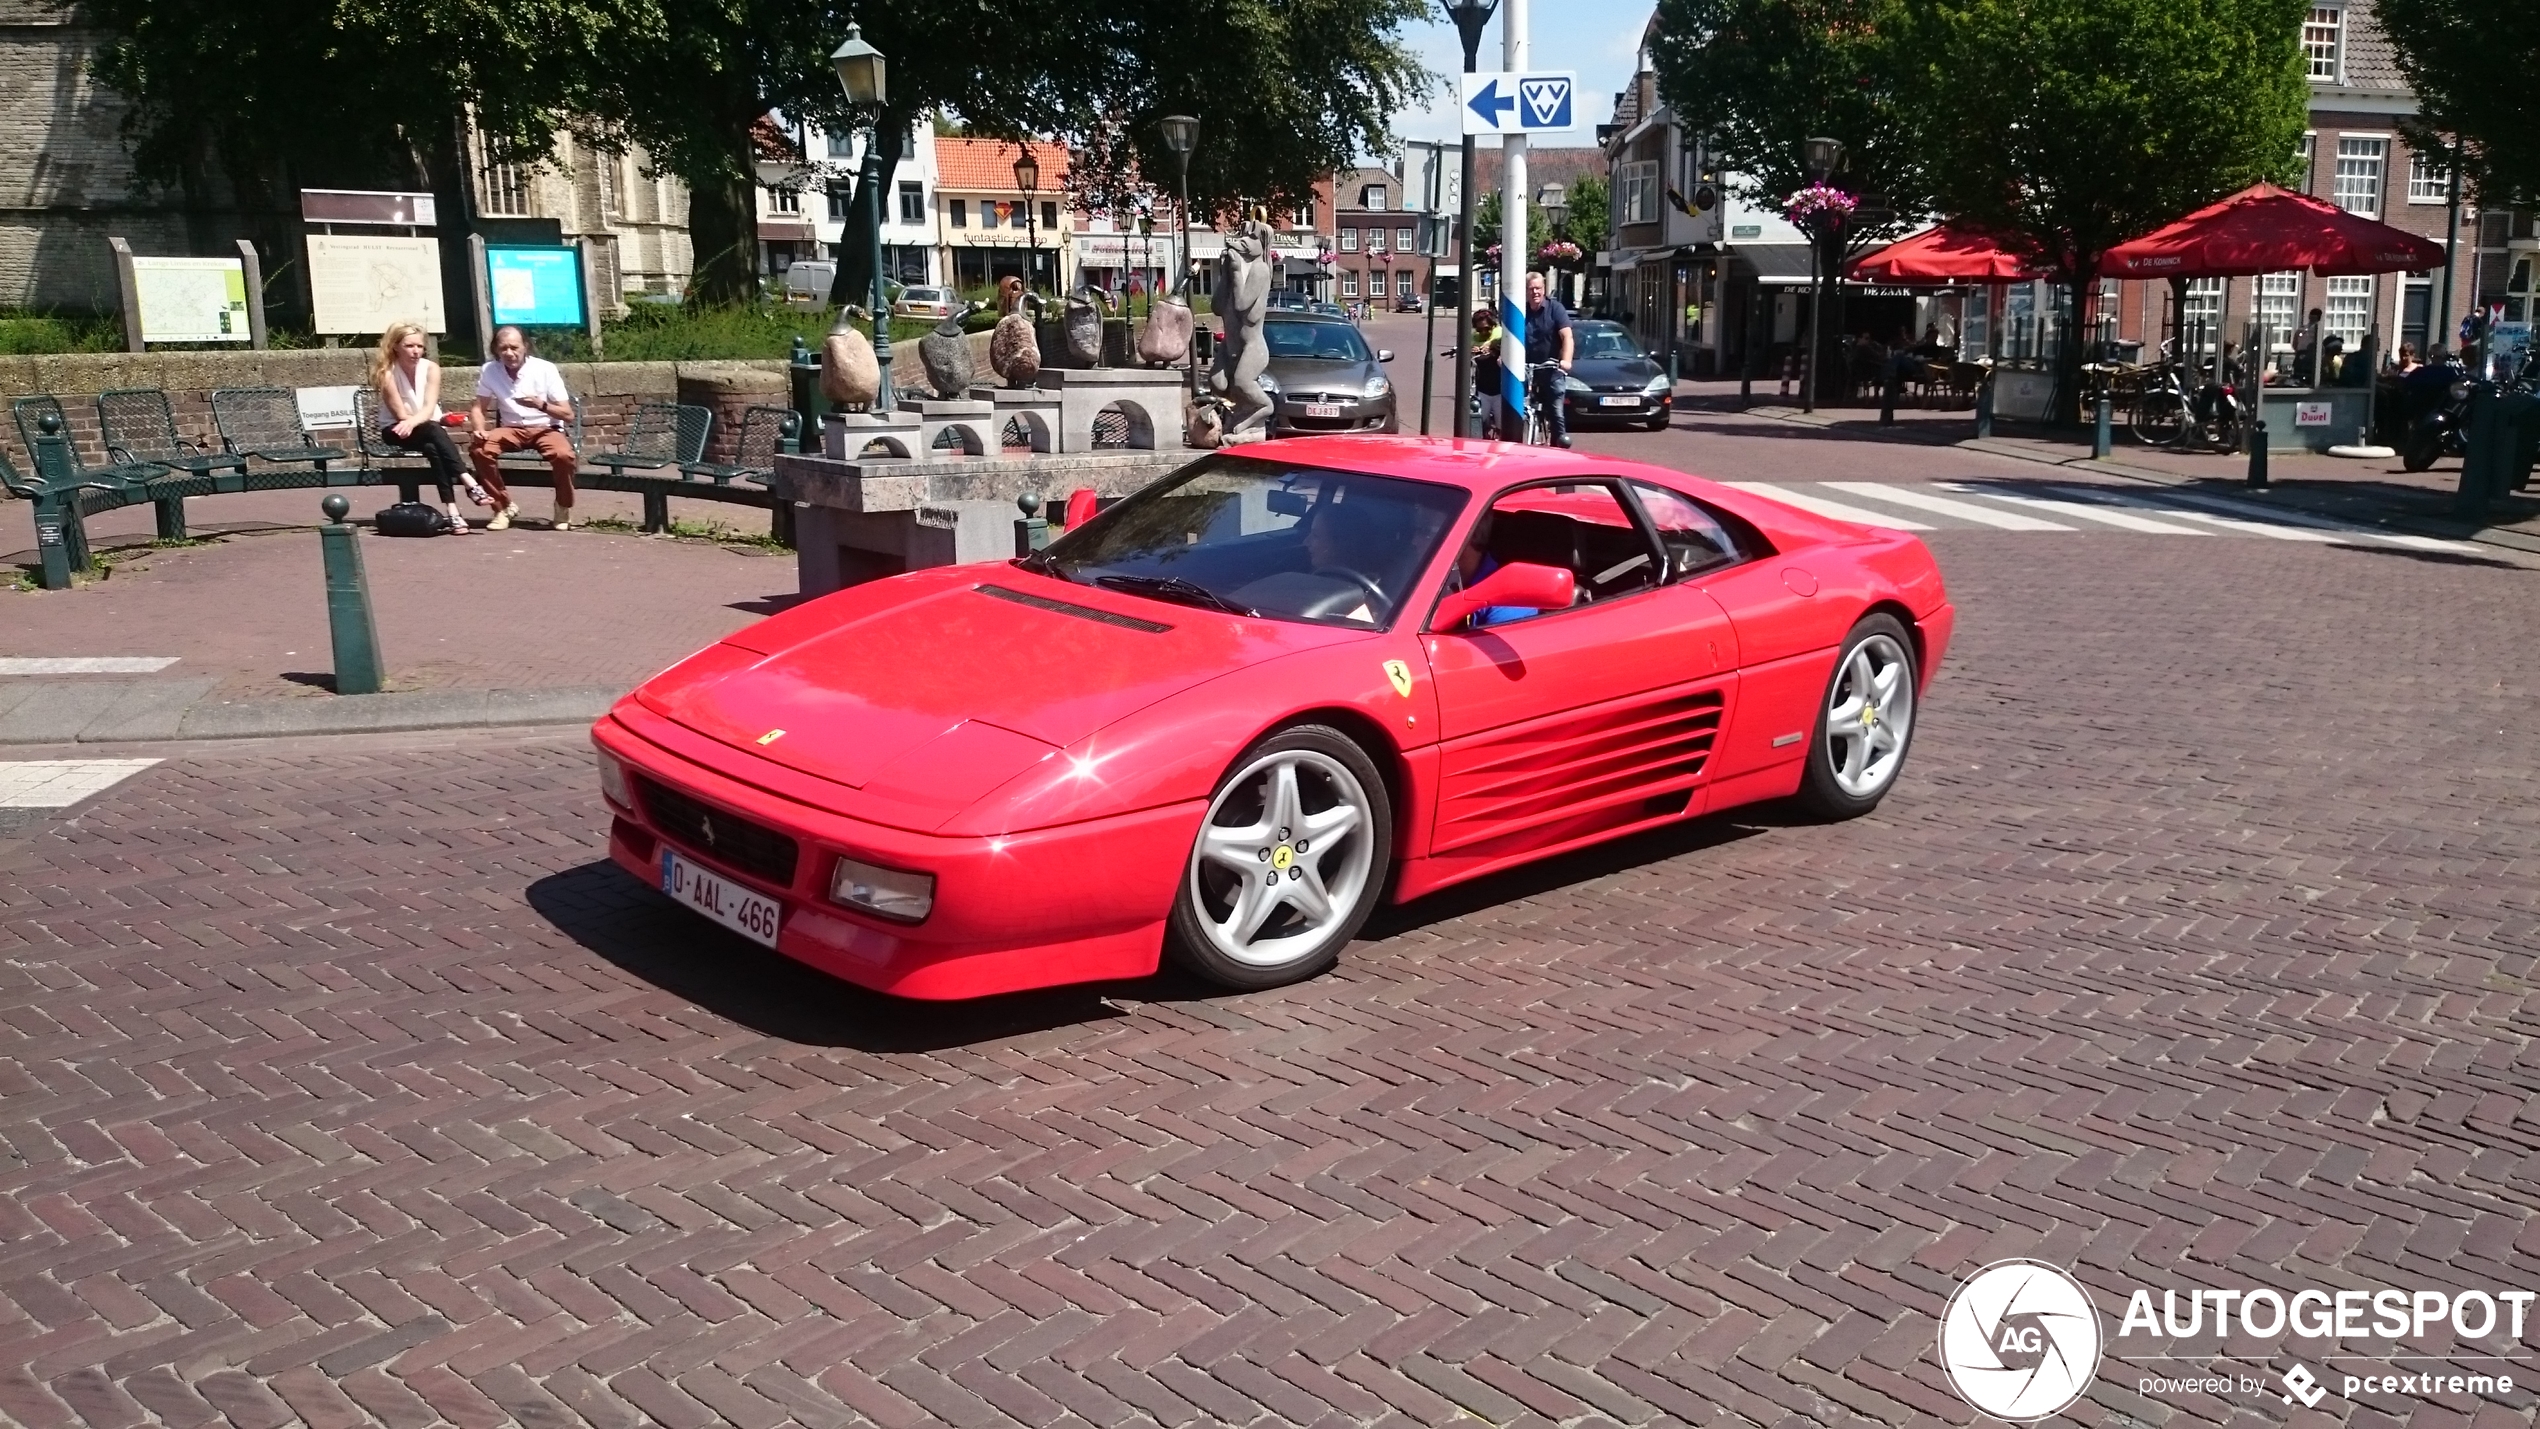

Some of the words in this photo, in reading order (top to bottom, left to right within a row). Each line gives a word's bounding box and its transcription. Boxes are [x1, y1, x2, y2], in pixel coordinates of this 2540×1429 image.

[964, 233, 1009, 242] funtastic
[1013, 235, 1047, 244] casno
[2143, 257, 2152, 266] DE
[2153, 256, 2181, 266] KONINCK
[1863, 286, 1878, 296] DE
[1880, 286, 1911, 297] ZAAK
[302, 411, 330, 420] Toegang
[330, 409, 356, 417] BASILIE
[2301, 411, 2327, 421] Duvel
